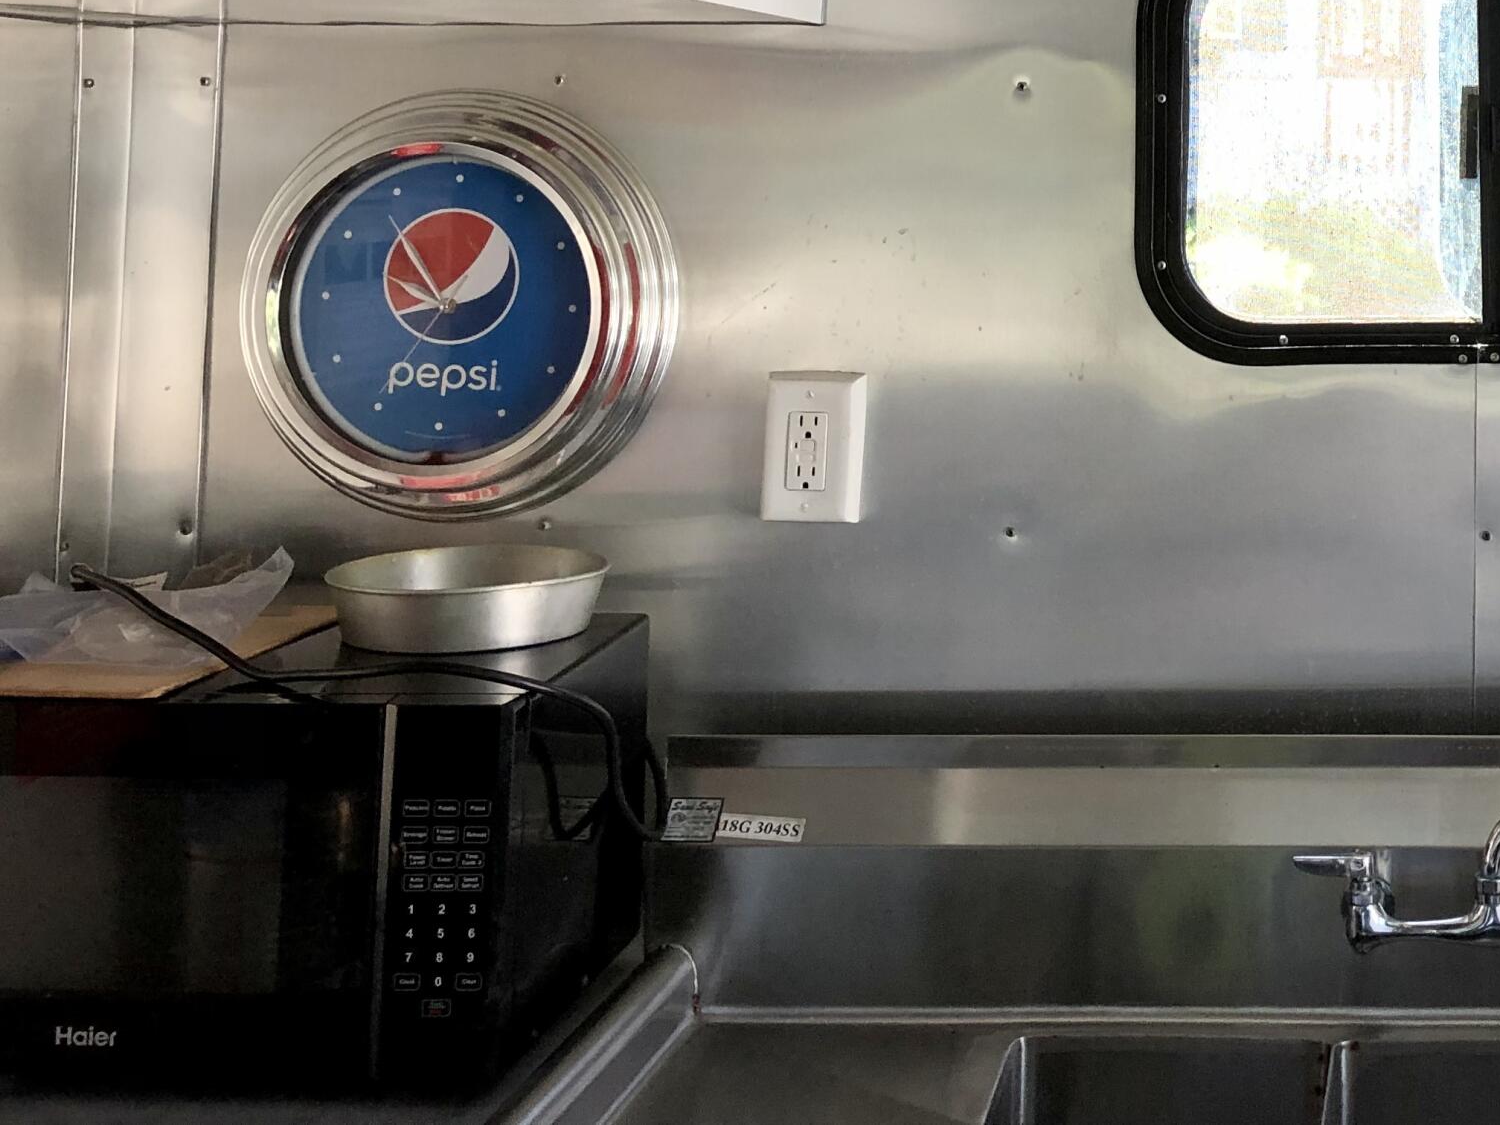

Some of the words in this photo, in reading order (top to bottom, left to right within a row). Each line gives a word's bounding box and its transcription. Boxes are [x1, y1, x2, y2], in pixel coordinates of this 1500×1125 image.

[388, 360, 498, 397] pepsi
[721, 819, 752, 834] 18G
[754, 821, 800, 837] 304SS
[408, 903, 414, 915] 1
[438, 903, 446, 915] 2
[469, 903, 477, 915] 3
[405, 928, 414, 939] 4
[437, 927, 445, 939] 5
[468, 927, 476, 939] 6
[405, 952, 413, 963] 7
[436, 952, 444, 963] 8
[466, 952, 474, 963] 9
[434, 976, 442, 987] 0
[55, 1025, 117, 1046] Haier
